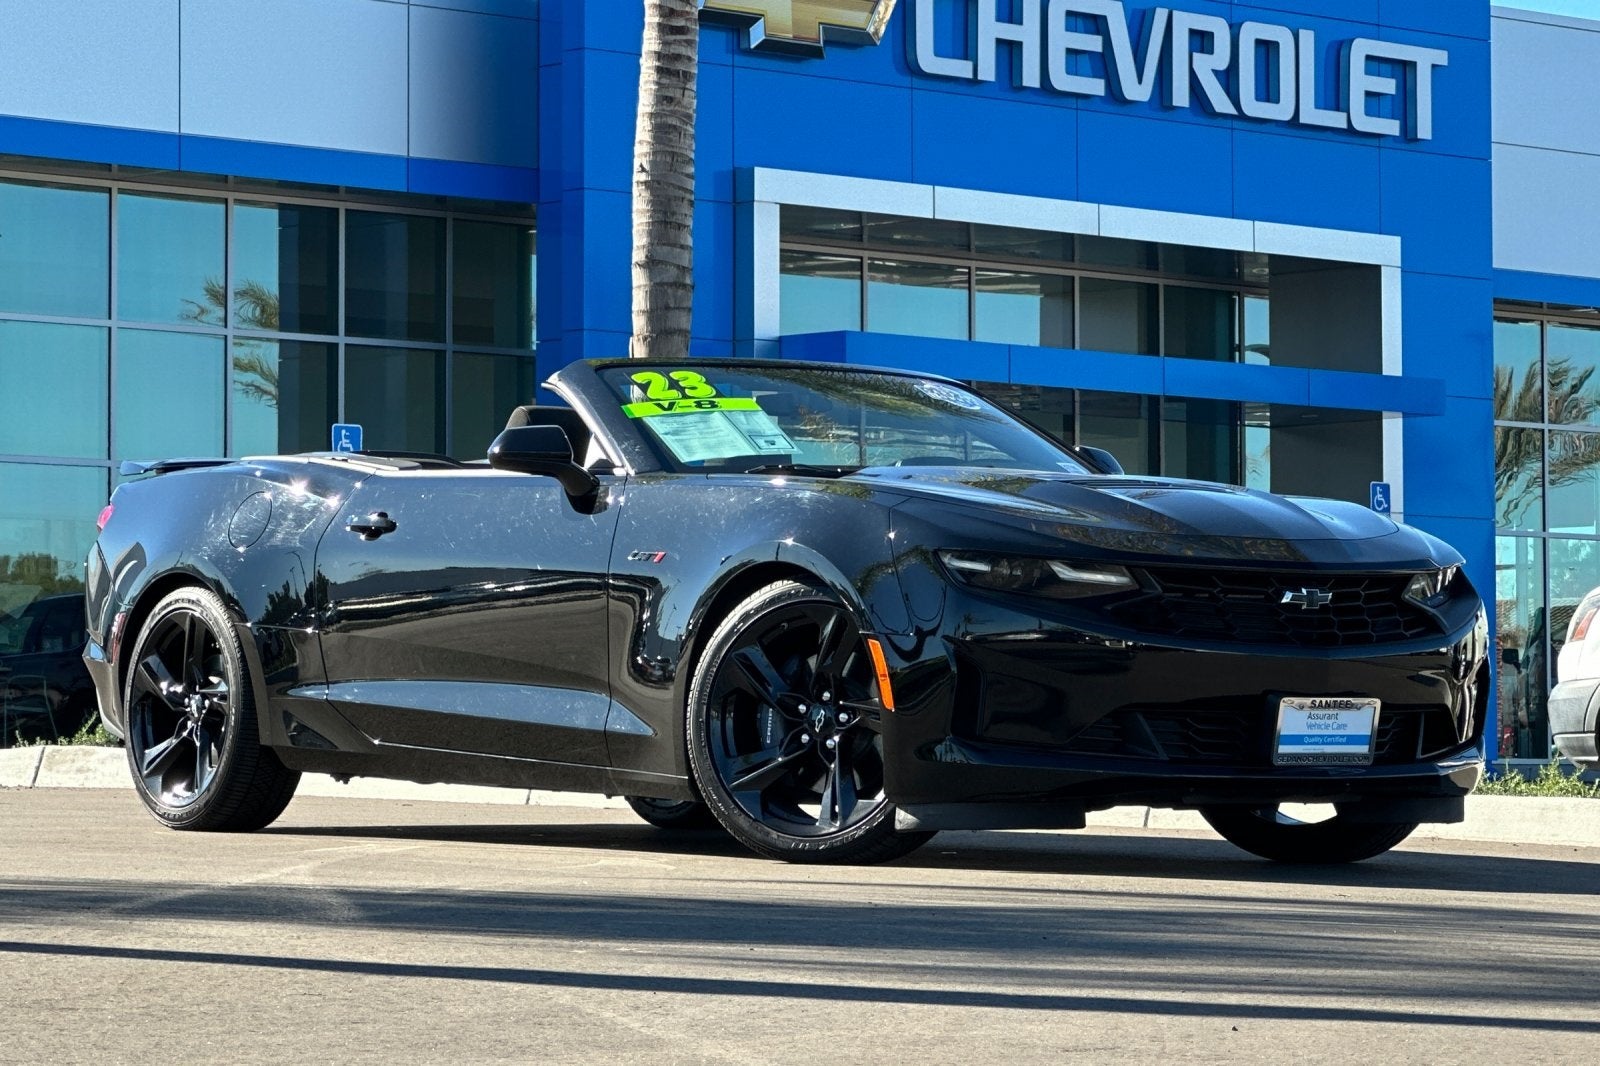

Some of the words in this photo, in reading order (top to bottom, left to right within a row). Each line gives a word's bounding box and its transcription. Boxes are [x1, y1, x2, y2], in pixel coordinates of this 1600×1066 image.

[911, 0, 1449, 140] CHEVROLET
[630, 371, 716, 400] 23
[652, 400, 719, 412] V-8
[1309, 699, 1353, 709] SANTEE
[1307, 711, 1339, 720] Assurant
[1306, 721, 1330, 730] Vehicle
[1331, 721, 1348, 730] Care
[1303, 736, 1322, 744] Quality
